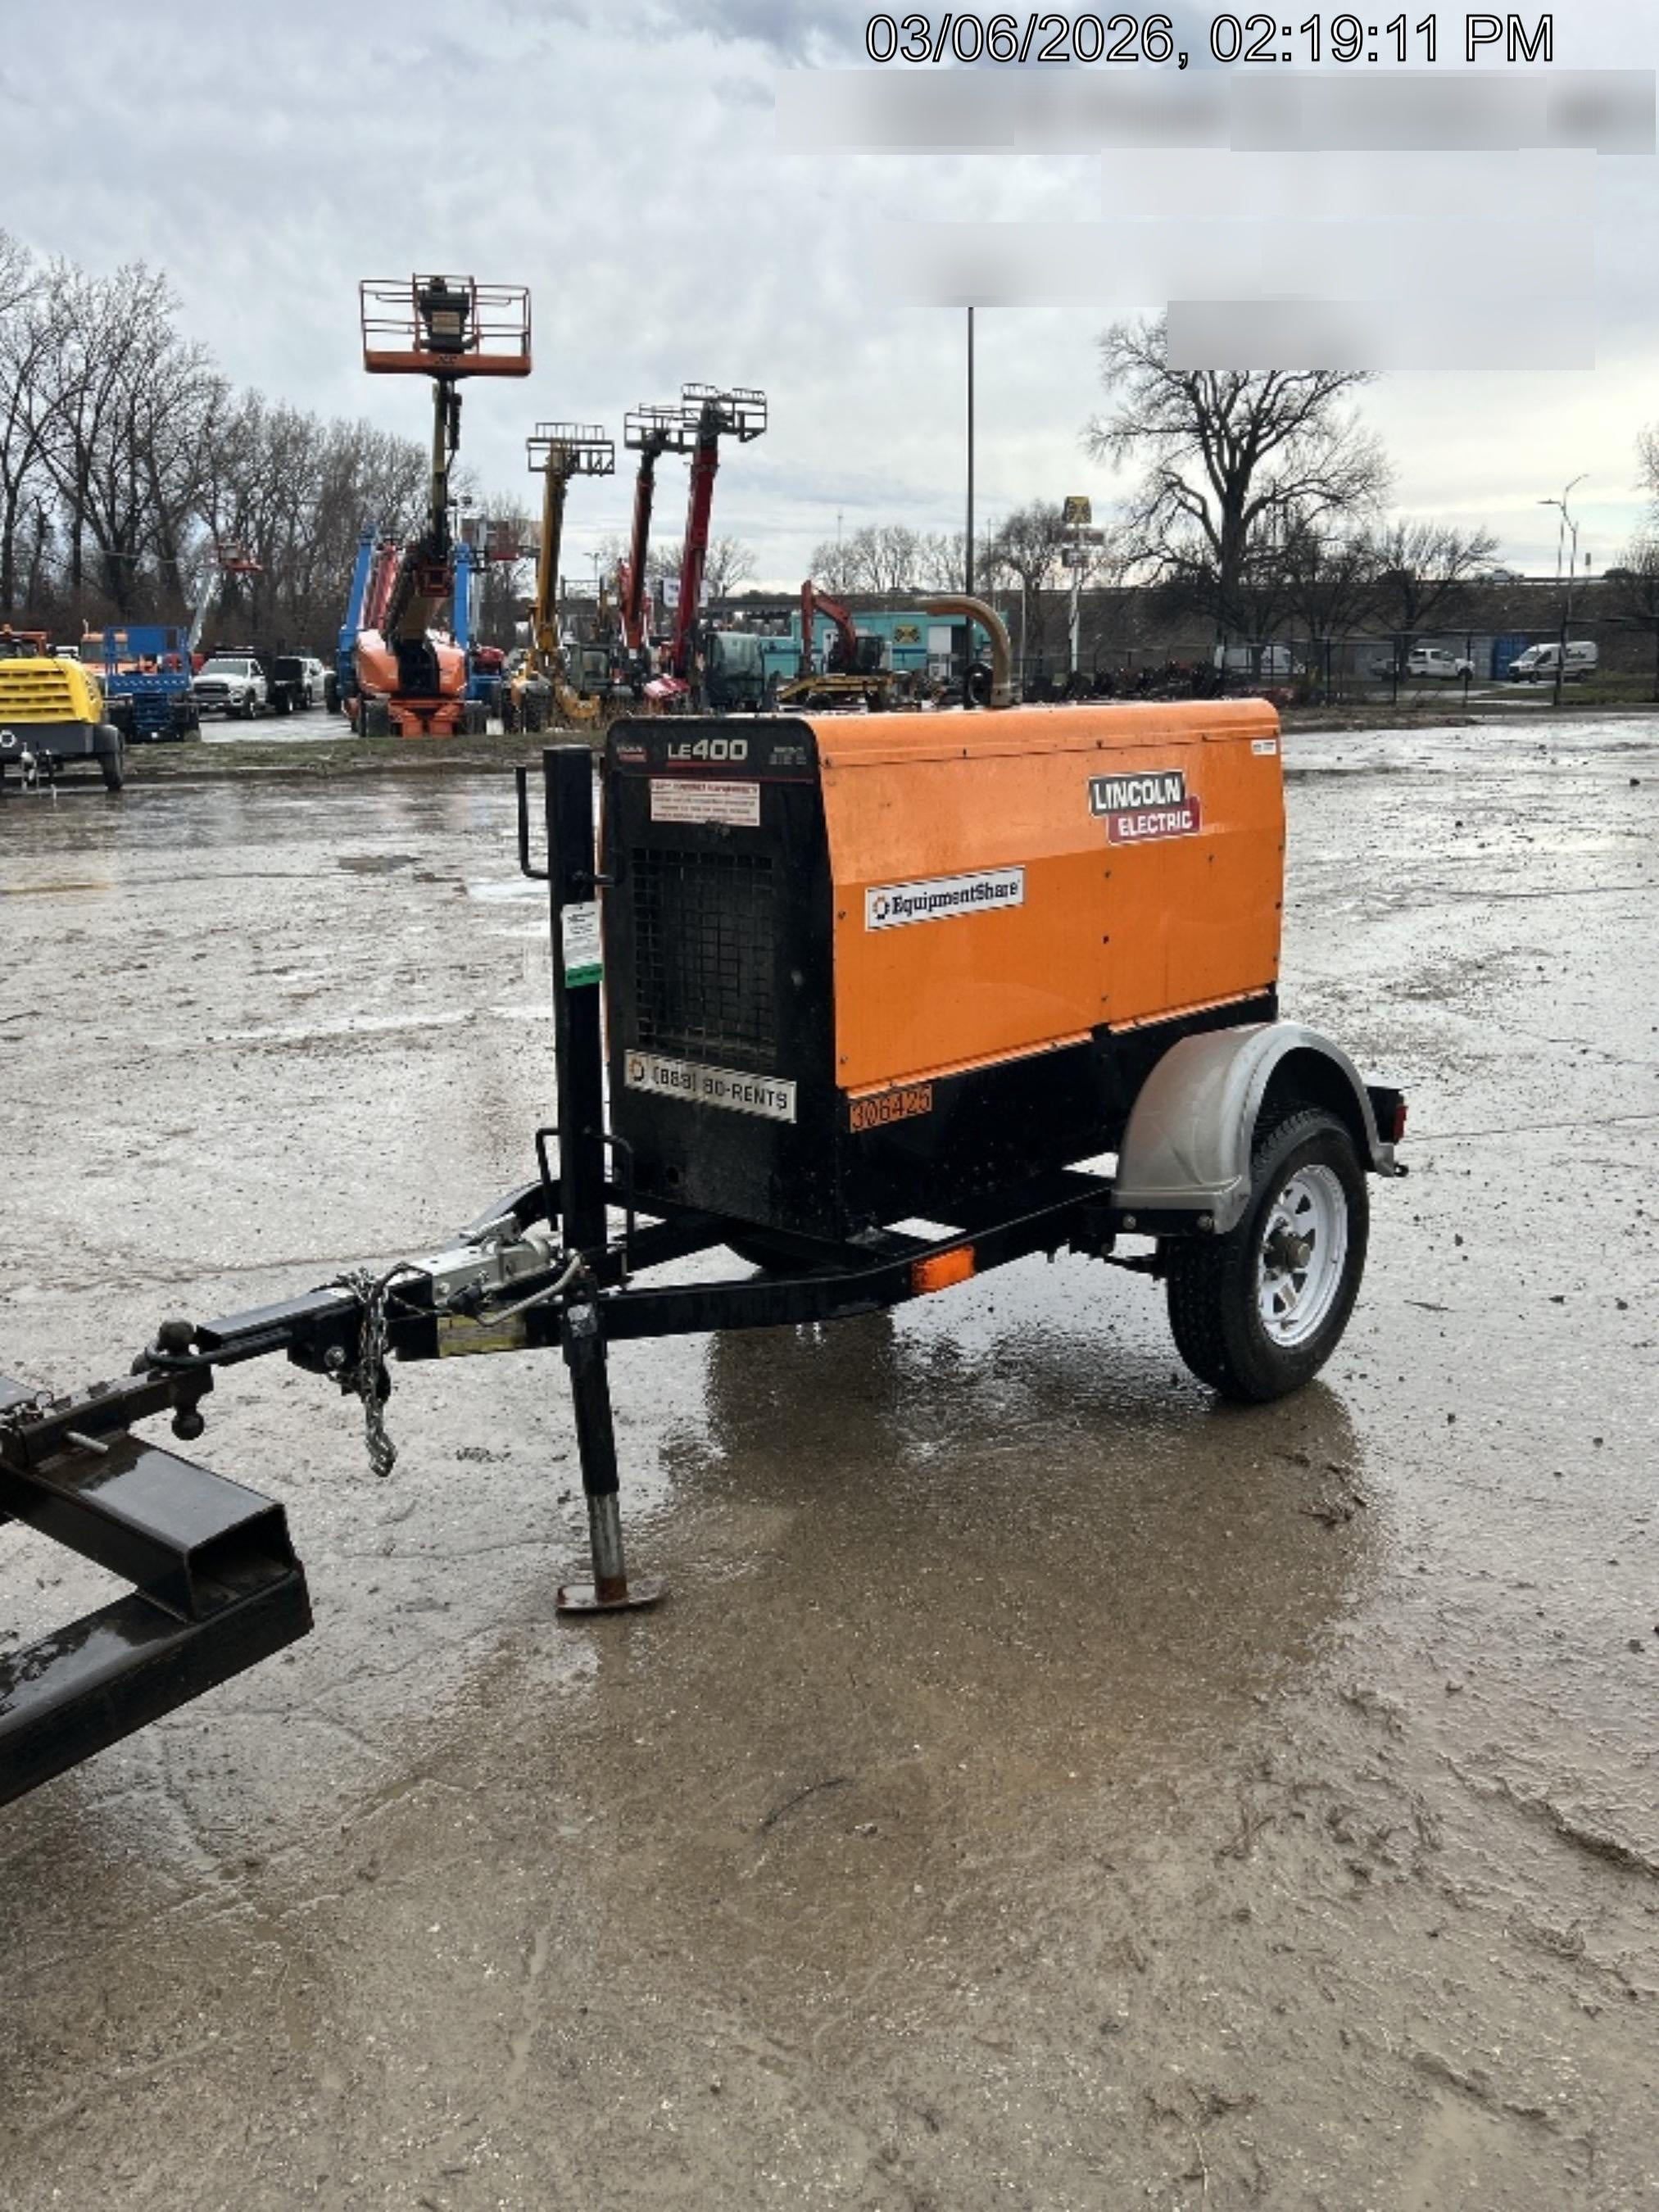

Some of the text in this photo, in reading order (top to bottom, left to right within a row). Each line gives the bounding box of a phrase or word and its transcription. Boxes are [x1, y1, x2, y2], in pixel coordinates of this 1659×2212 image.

[667, 738, 749, 761] LE400
[1093, 777, 1181, 810] LINCOLN
[1117, 809, 1193, 837] ELECTRIC
[891, 881, 1018, 917] EquipmentShare
[852, 1085, 931, 1129] 306425
